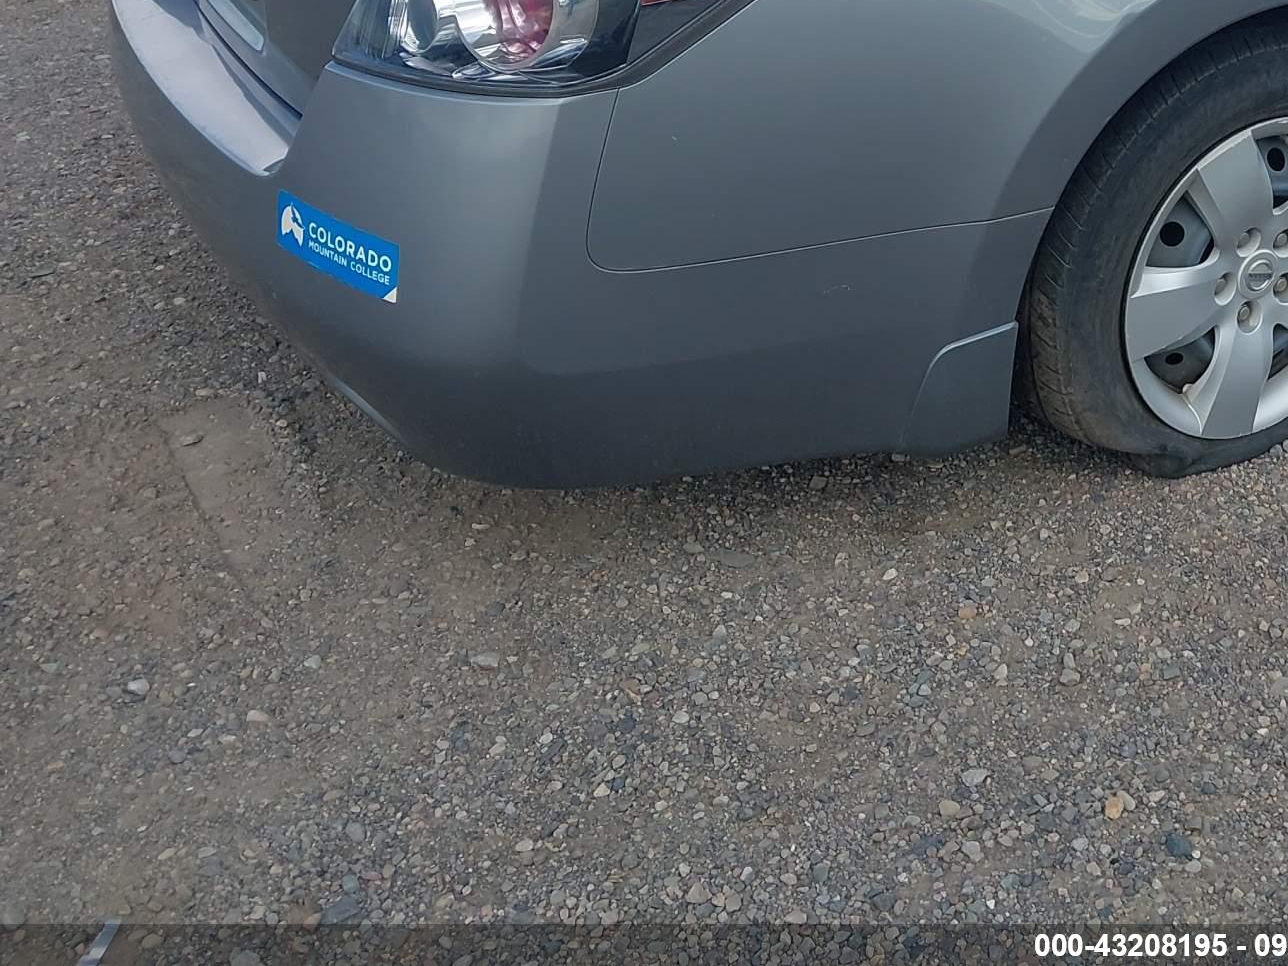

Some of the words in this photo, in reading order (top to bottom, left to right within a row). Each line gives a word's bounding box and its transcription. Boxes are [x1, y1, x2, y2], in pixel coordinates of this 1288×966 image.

[308, 222, 392, 273] COLORADO
[308, 239, 348, 268] MOUNTAIN
[350, 261, 391, 286] COLLEGE
